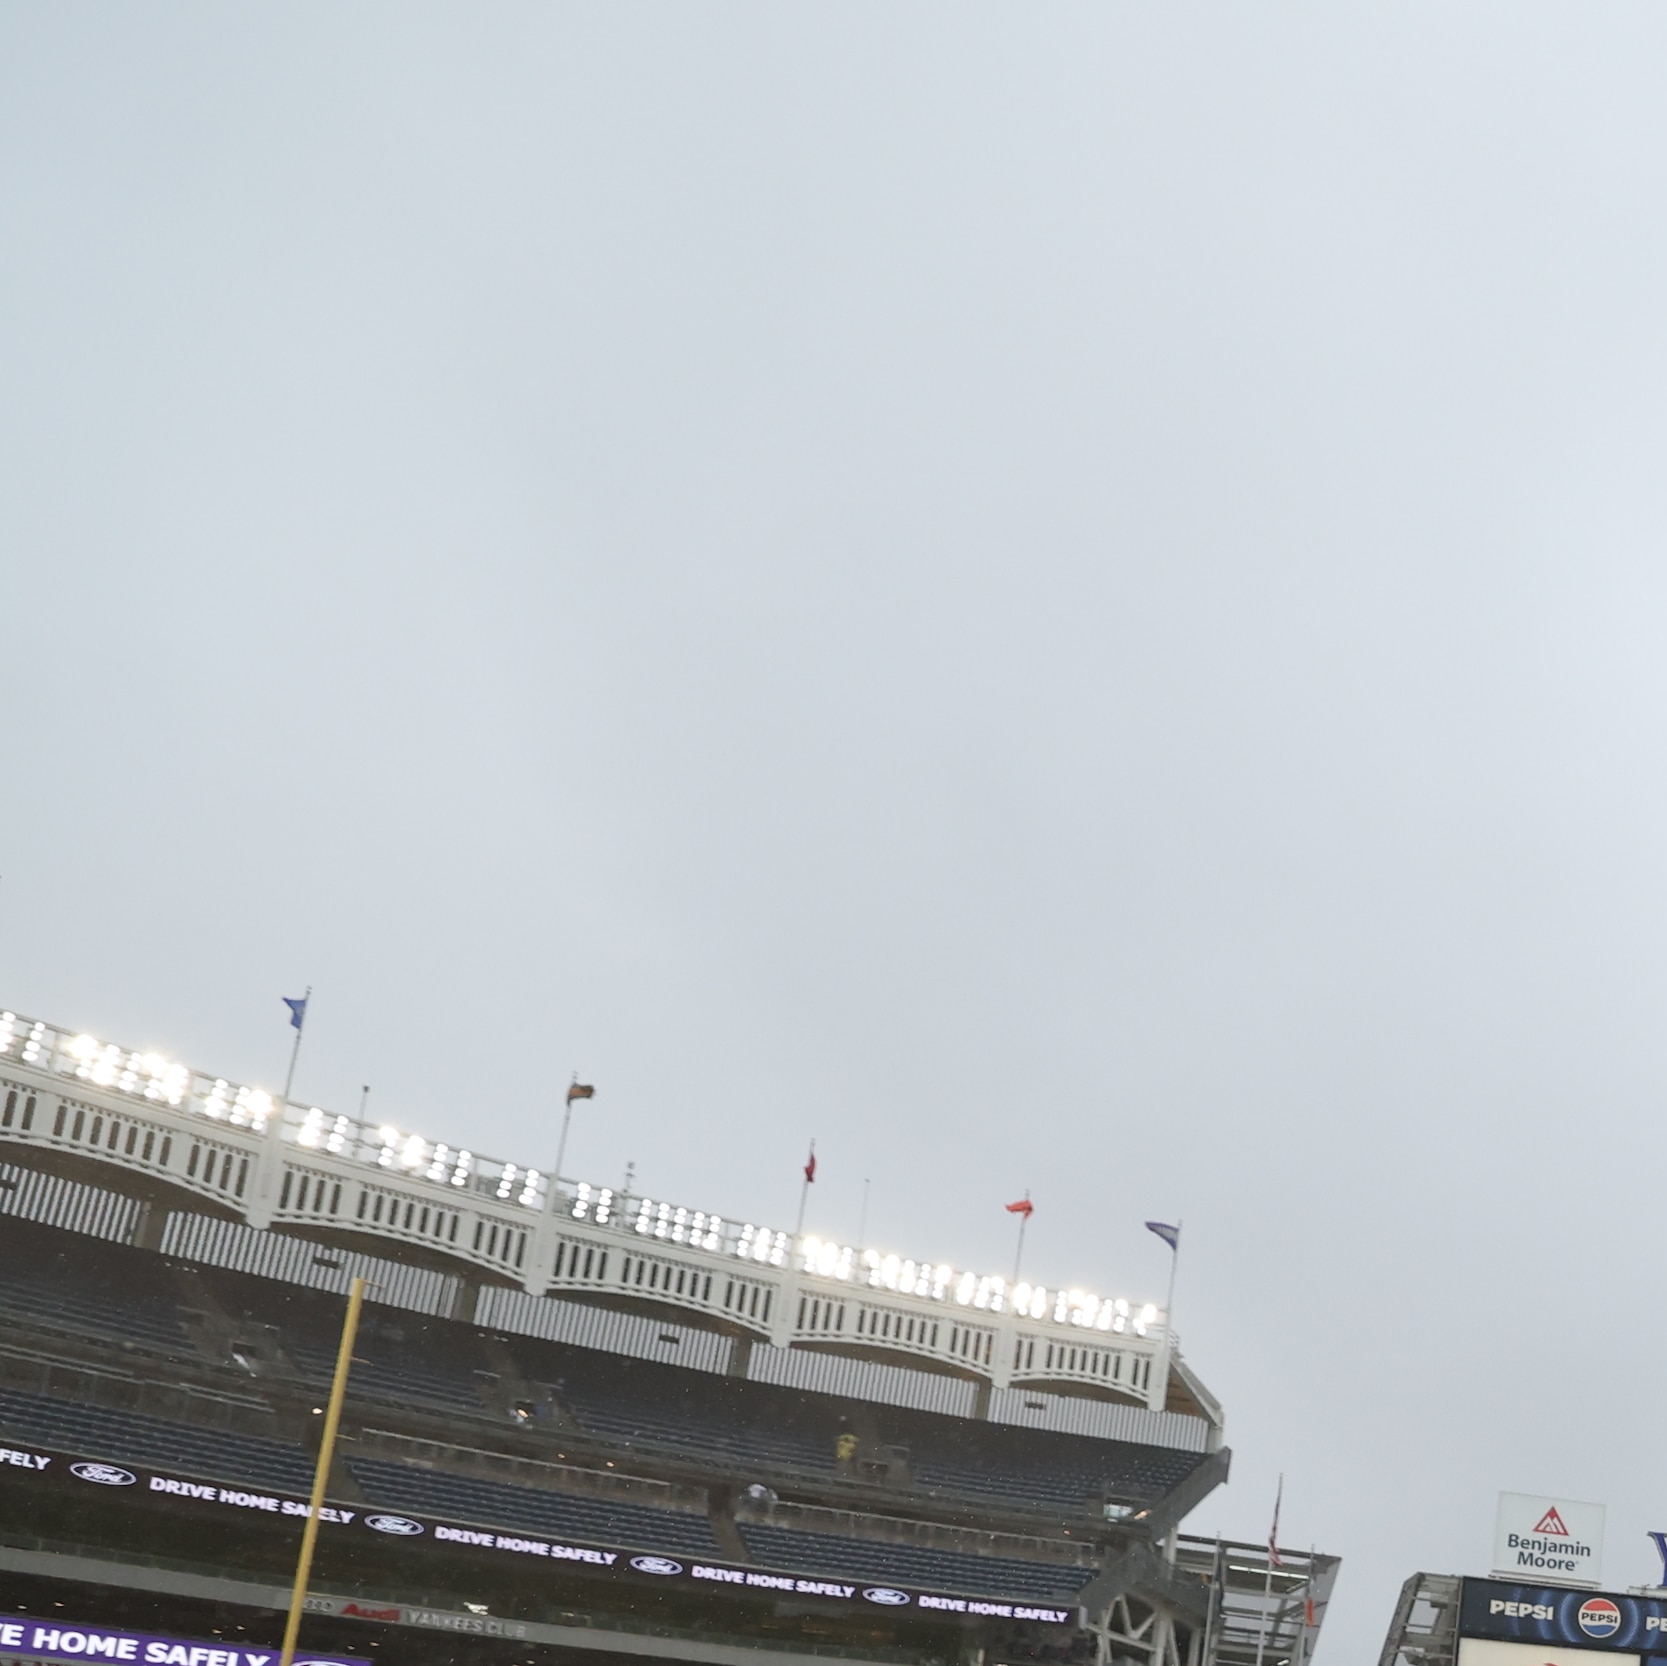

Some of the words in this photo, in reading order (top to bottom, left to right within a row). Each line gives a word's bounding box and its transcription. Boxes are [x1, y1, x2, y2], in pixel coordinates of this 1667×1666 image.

[150, 1476, 216, 1501] DRIVE
[219, 1489, 280, 1513] HOME
[435, 1527, 495, 1548] DRIVE
[497, 1536, 550, 1557] HOME
[551, 1545, 618, 1566] SAFELY
[1508, 1534, 1591, 1557] Benjamin
[1517, 1551, 1576, 1571] Moore
[692, 1565, 746, 1585] DRIVE
[746, 1574, 794, 1591] HOME
[795, 1580, 855, 1599] SAFELY
[919, 1596, 967, 1613] DRIVE
[968, 1602, 1012, 1618] HOME
[1014, 1606, 1068, 1624] SAFELY
[1490, 1600, 1554, 1620] PEPSI
[1582, 1613, 1617, 1624] PEPSI
[33, 1627, 139, 1660] HOME
